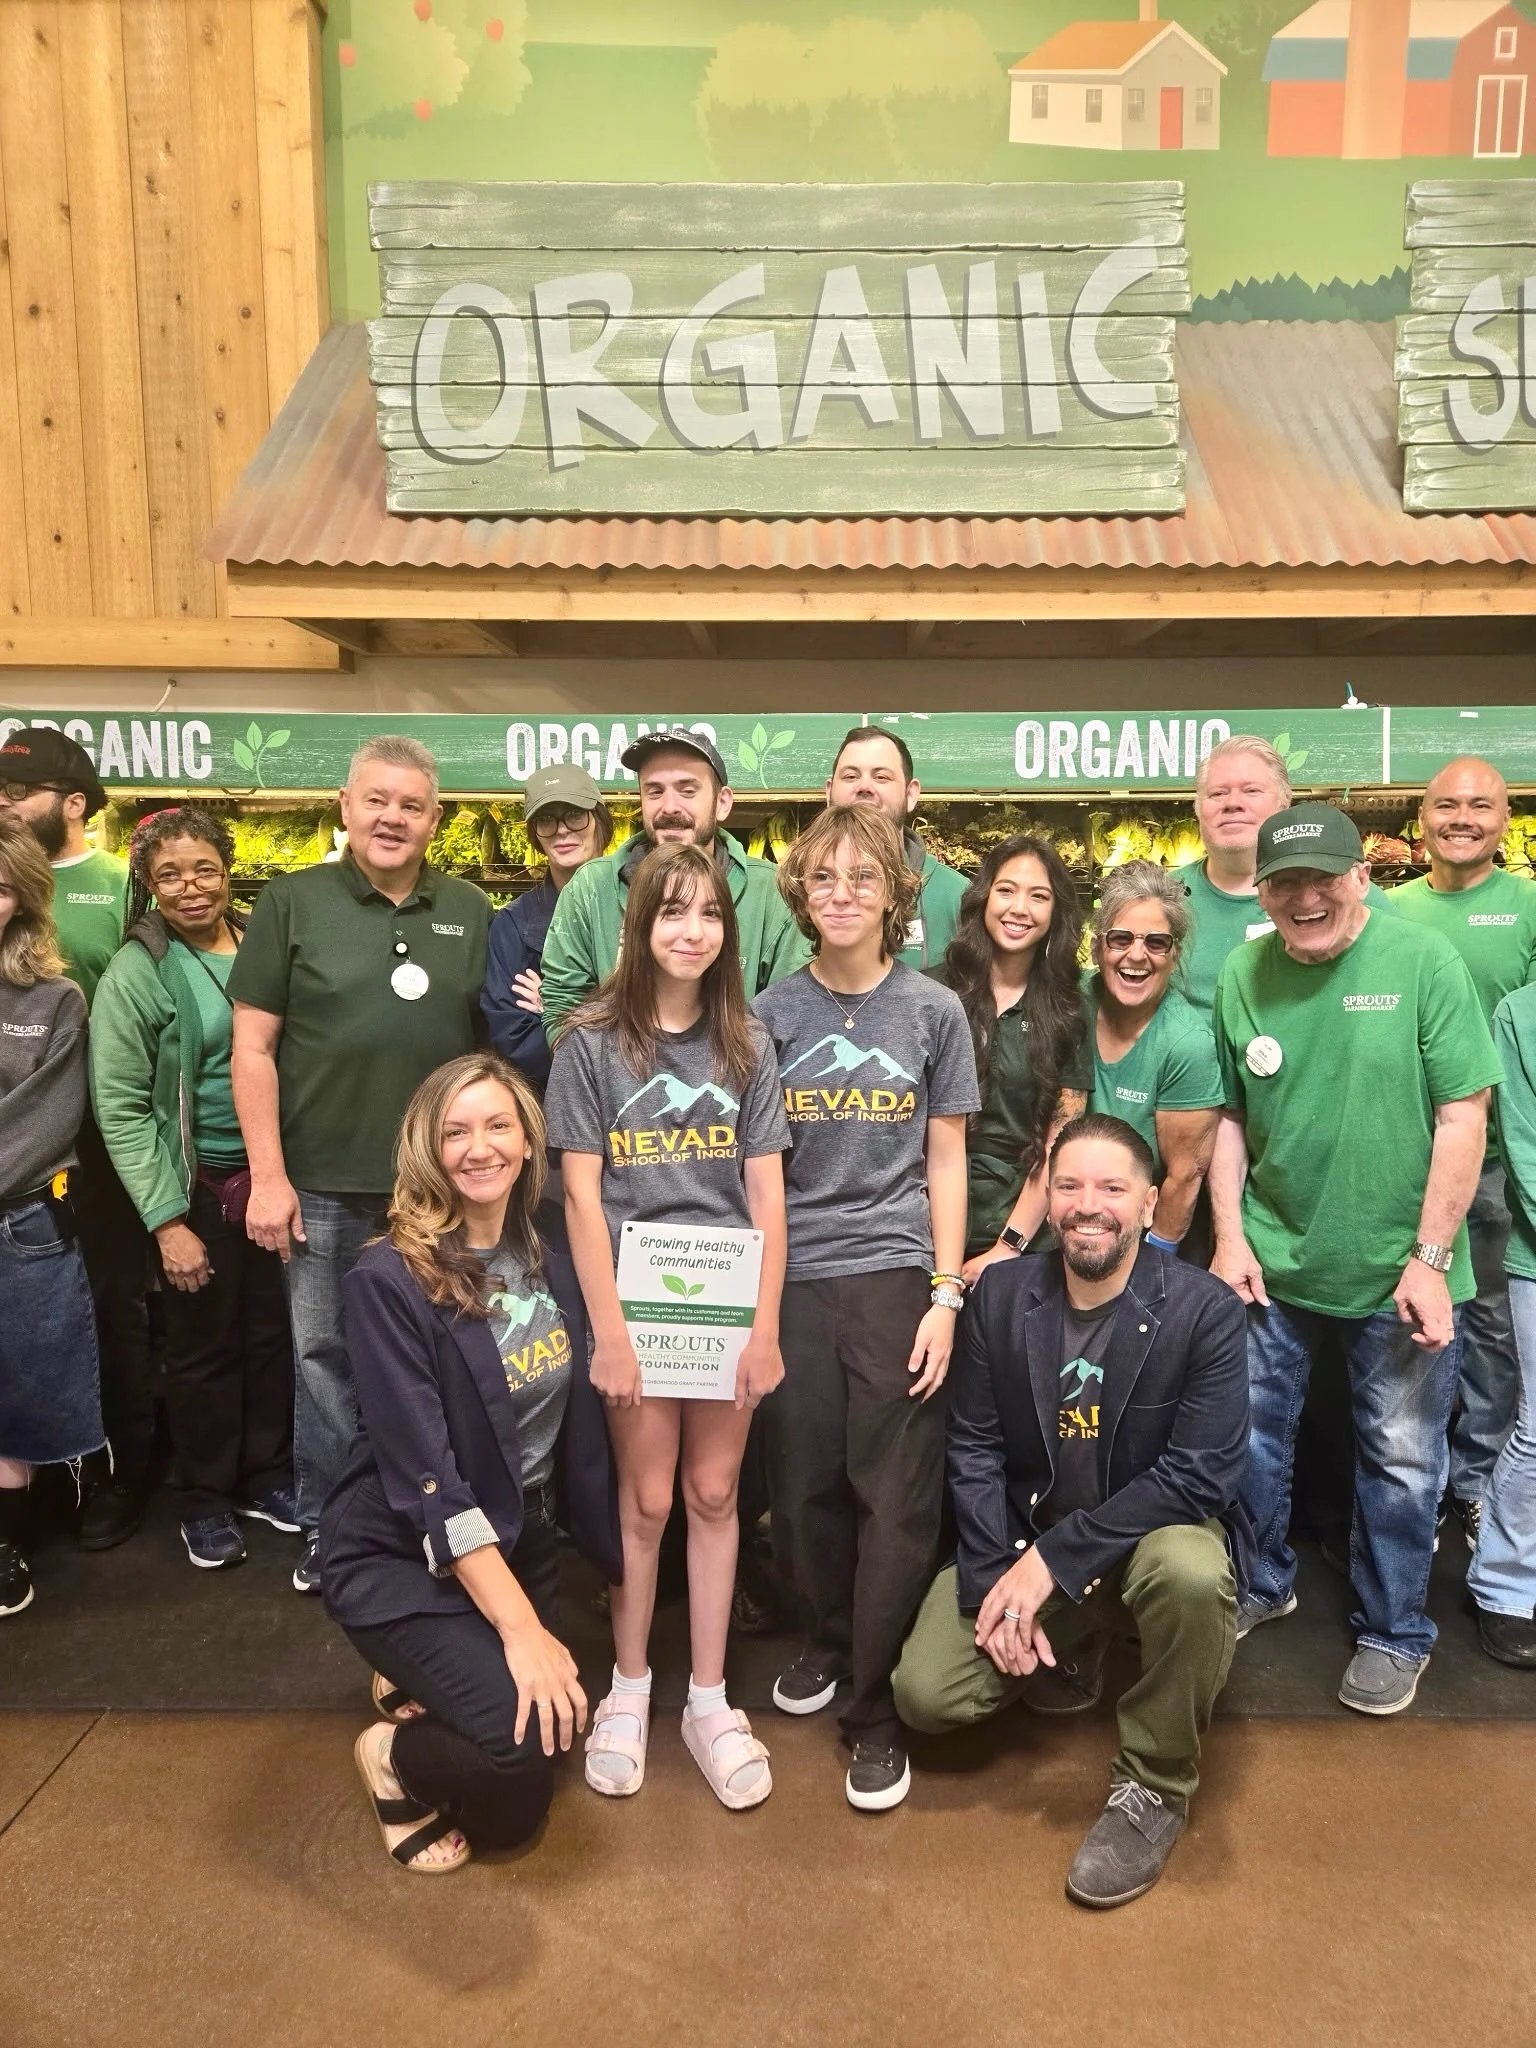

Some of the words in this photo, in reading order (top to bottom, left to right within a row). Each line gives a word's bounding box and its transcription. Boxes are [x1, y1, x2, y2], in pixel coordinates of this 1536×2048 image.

[413, 235, 1159, 470] ORGANIC
[1446, 274, 1536, 452] S
[0, 718, 212, 779] GANIC
[506, 722, 717, 781] ORGA
[1272, 823, 1324, 840] SPROUTS
[66, 893, 114, 902] SPROUTS
[1467, 914, 1517, 922] SPROUTS
[431, 923, 465, 933] SPROUTS
[1343, 994, 1400, 1007] SPROUTS
[2, 1022, 46, 1033] SPROUTS
[1115, 1086, 1149, 1100] SPROUTS
[787, 1112, 829, 1123] HOOL
[833, 1111, 855, 1121] OF
[857, 1110, 913, 1123] INQUIRY
[608, 1124, 738, 1156] NEVAD
[613, 1153, 670, 1167] SHOOL
[671, 1152, 692, 1162] OF
[696, 1148, 738, 1161] INQU
[640, 1236, 691, 1253] Growing
[694, 1239, 745, 1257] Healthy
[649, 1254, 732, 1270] Communities
[636, 1333, 725, 1352] SPROUTS
[639, 1360, 719, 1371] FOUNDATION
[671, 1354, 721, 1363] COMMUNITIES
[526, 1366, 545, 1383] OF
